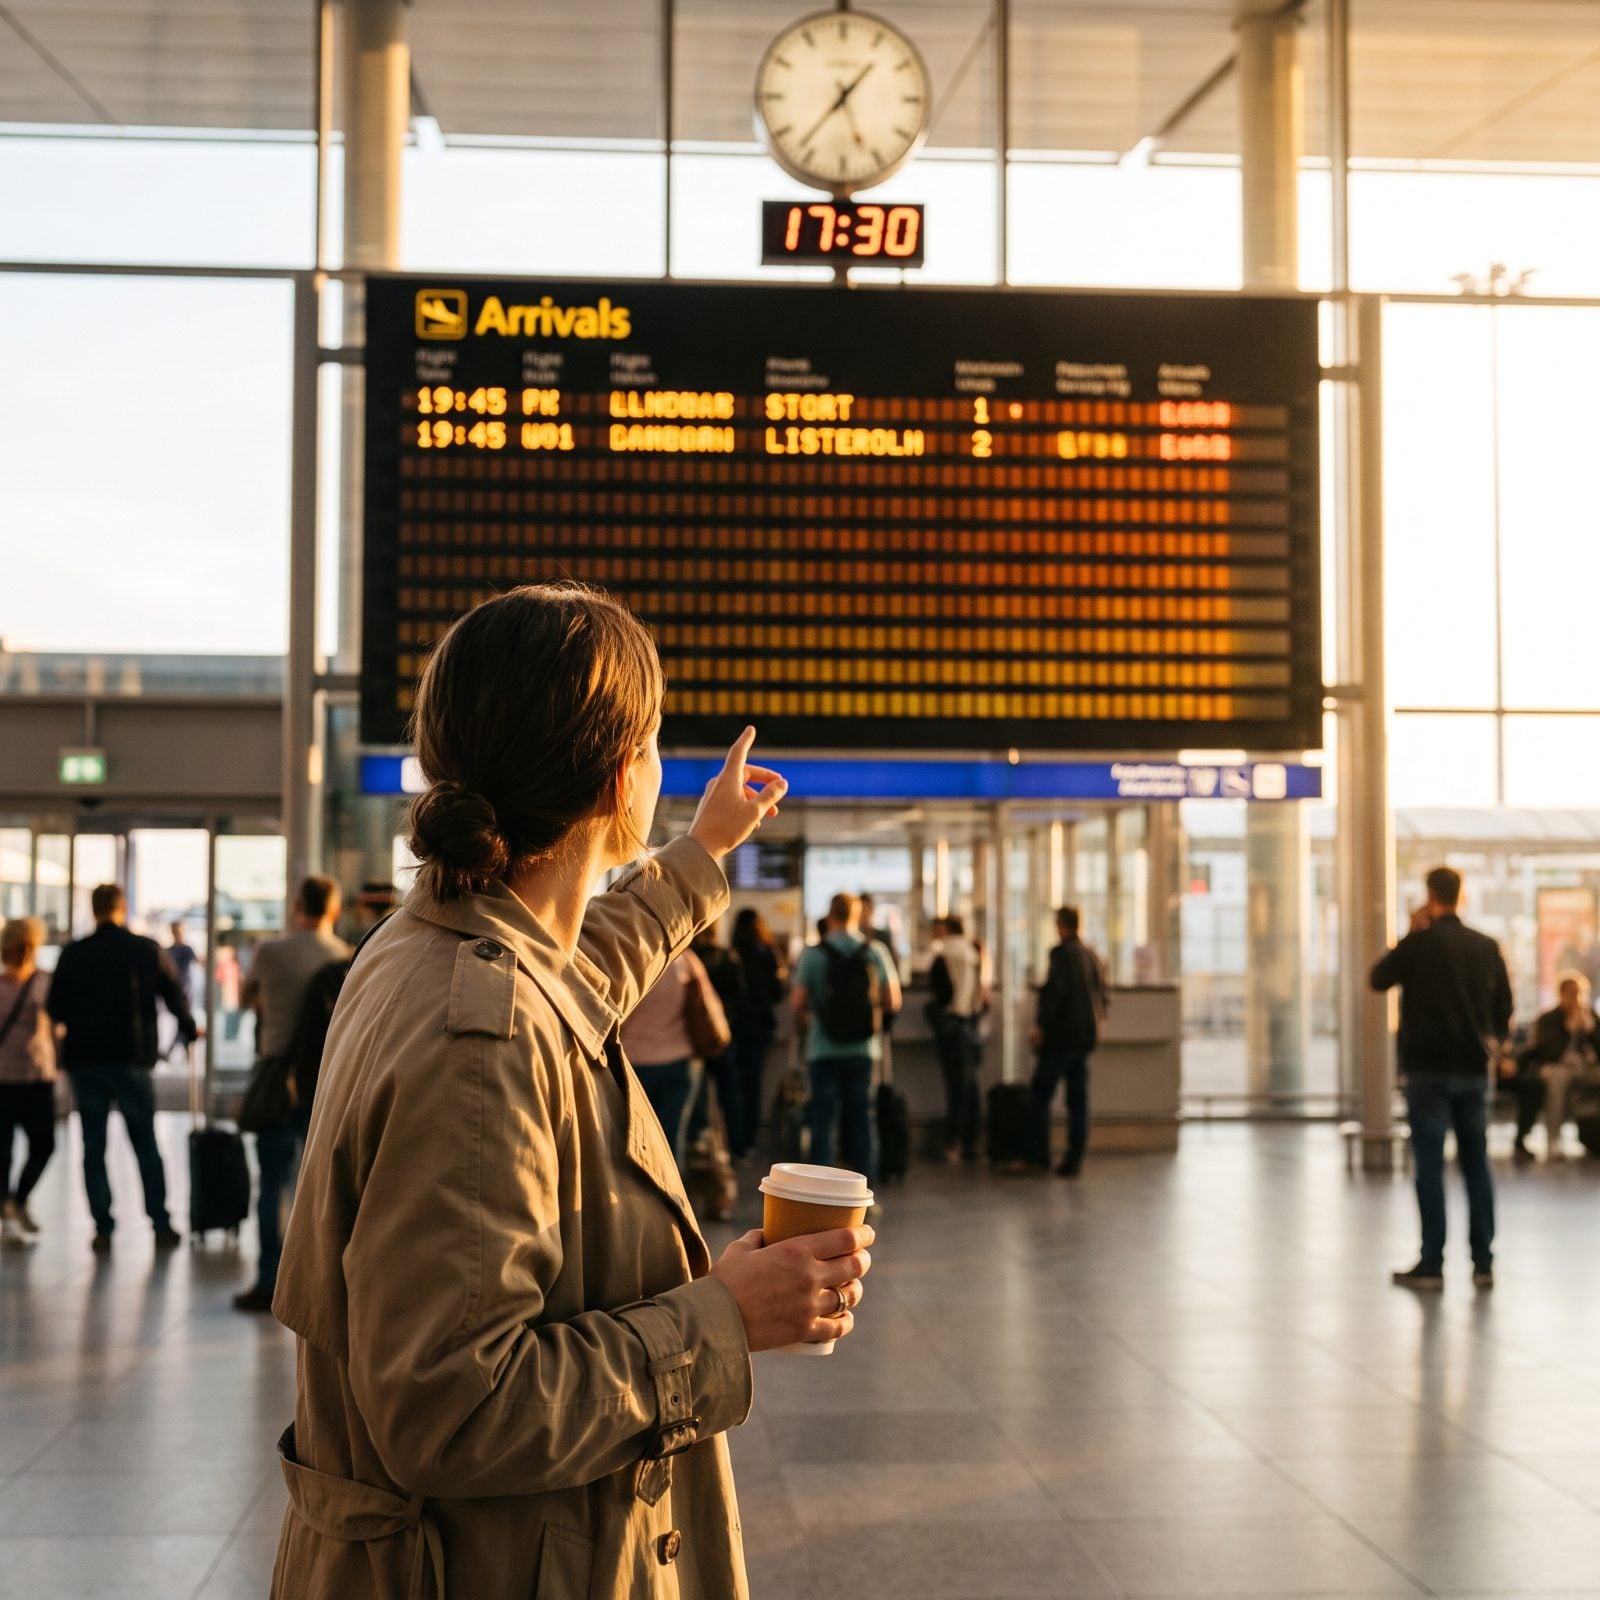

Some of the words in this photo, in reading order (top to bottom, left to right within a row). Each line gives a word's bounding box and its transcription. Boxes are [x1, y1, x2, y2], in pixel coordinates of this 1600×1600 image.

[785, 205, 920, 256] 17:30
[474, 295, 632, 340] Arrivals
[417, 386, 507, 415] 19:45
[973, 396, 990, 425] 1
[417, 420, 507, 449] 19:45
[971, 429, 993, 458] 2
